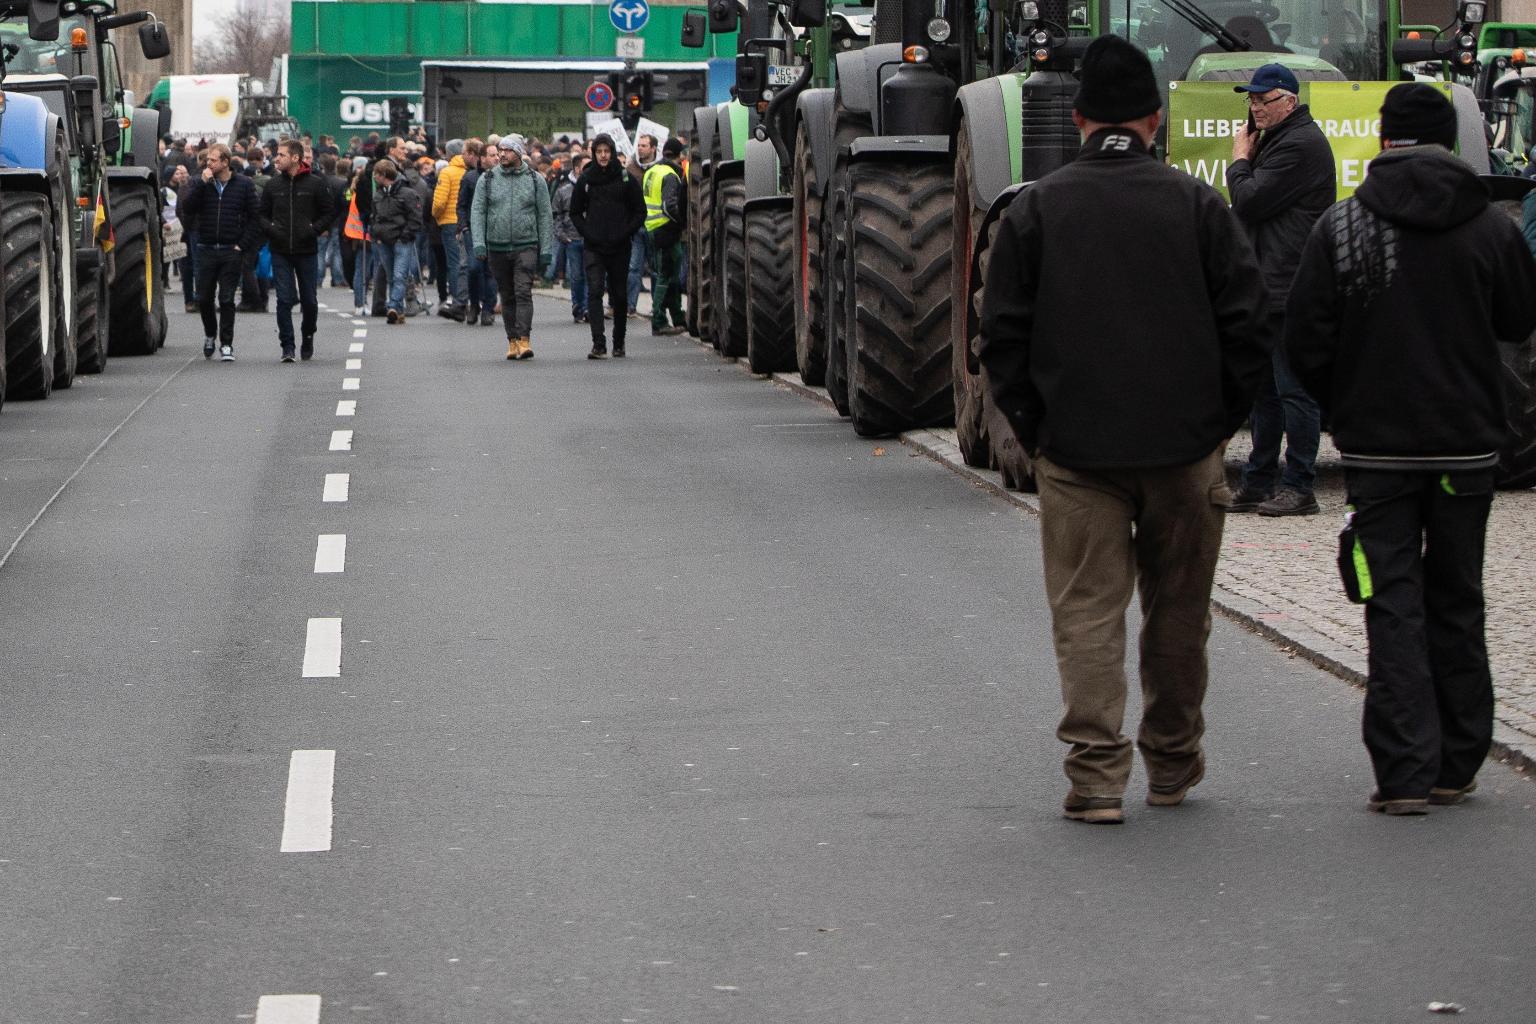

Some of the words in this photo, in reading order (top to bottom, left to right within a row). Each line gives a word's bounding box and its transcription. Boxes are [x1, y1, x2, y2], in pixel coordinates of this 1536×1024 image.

[774, 68, 791, 76] VEC
[1183, 119, 1249, 137] LIEBE
[1100, 134, 1132, 151] F3
